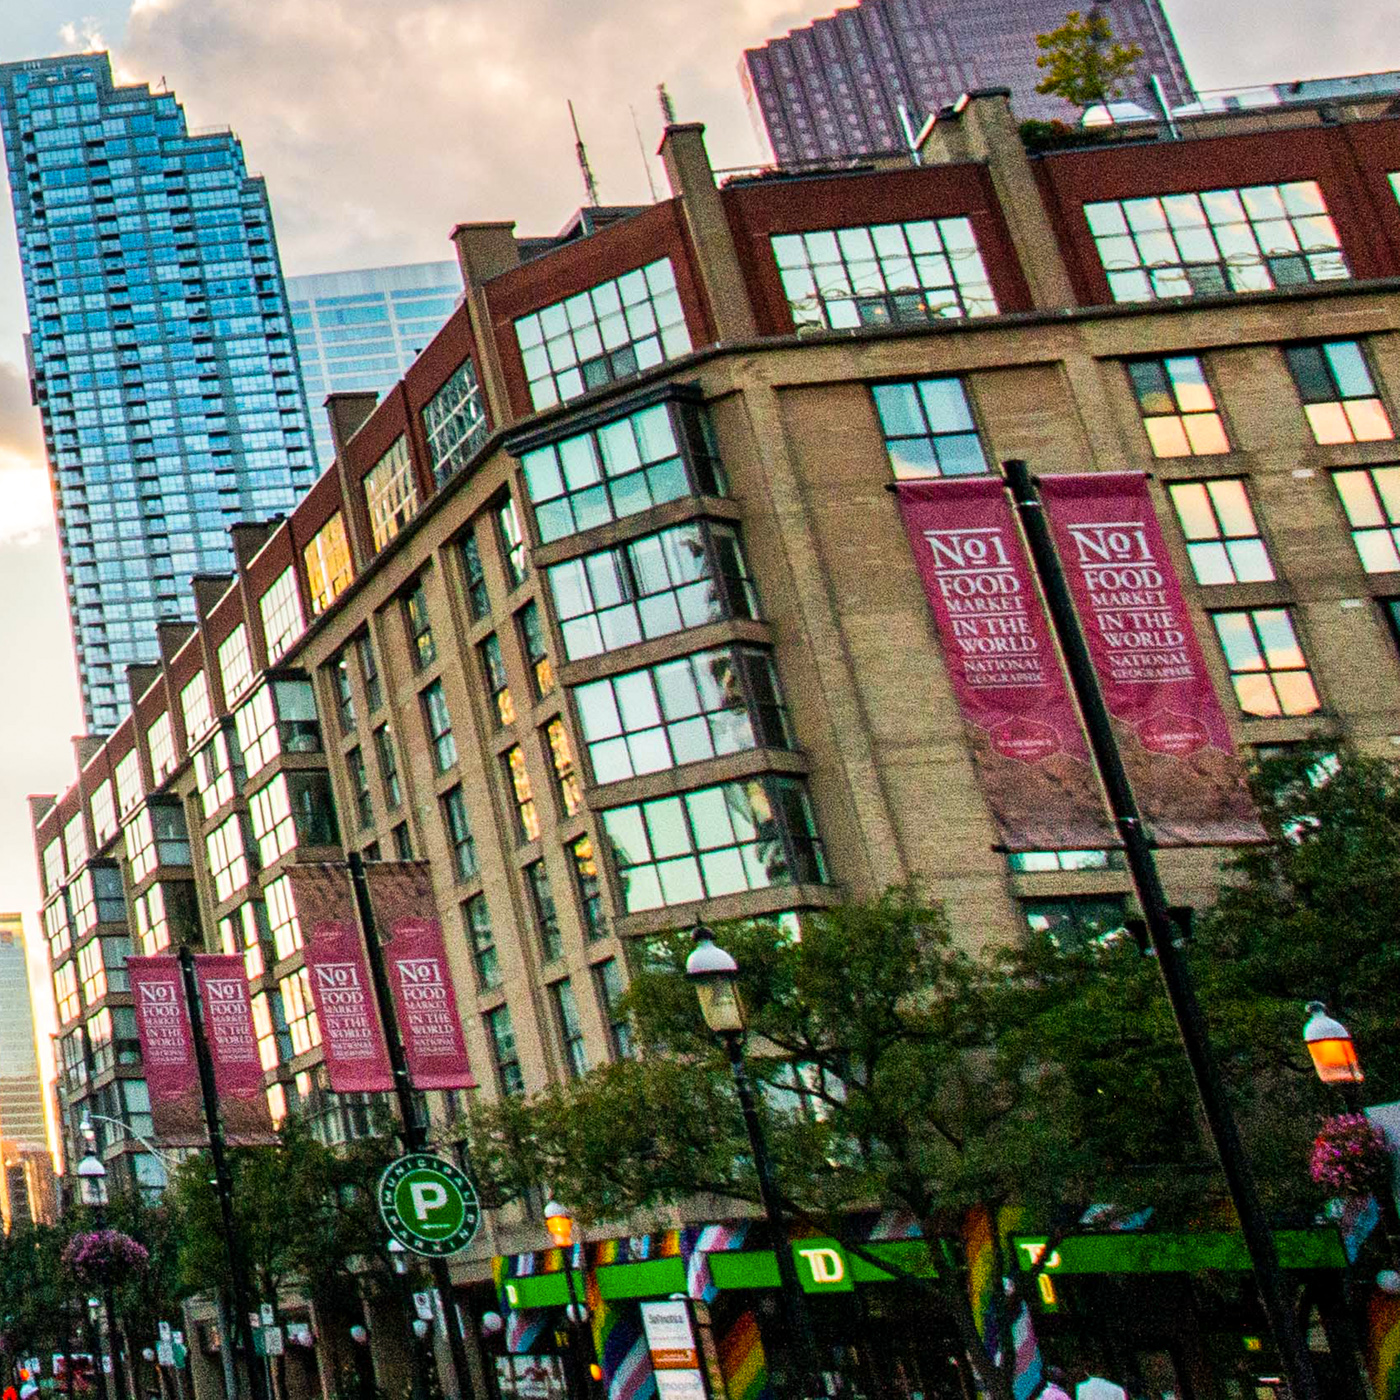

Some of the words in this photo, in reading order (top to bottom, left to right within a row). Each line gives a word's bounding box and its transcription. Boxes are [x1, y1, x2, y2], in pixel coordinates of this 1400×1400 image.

[938, 574, 1020, 596] FOOD
[1084, 569, 1163, 590] FOOD
[945, 596, 1024, 612] MARKET
[1090, 590, 1167, 606] MARKET
[952, 620, 979, 636] IN
[982, 617, 1032, 634] THE
[1097, 614, 1125, 630] IN
[1128, 612, 1178, 629] THE
[957, 635, 1038, 653] WORLD
[1102, 630, 1185, 648] WORLD
[964, 658, 1041, 672] NATIONAL
[1110, 651, 1191, 666] NATIONAL
[321, 991, 364, 1004] FOOD
[402, 987, 446, 1000] FOOD
[142, 1005, 179, 1017] FOOD
[210, 1004, 247, 1015] FOOD
[323, 1004, 367, 1014] MARKET
[404, 1000, 448, 1010] MARKET
[326, 1018, 343, 1028] IN
[344, 1016, 370, 1028] THE
[408, 1014, 424, 1024] IN
[425, 1012, 451, 1023] THE
[146, 1029, 159, 1039] IN
[162, 1027, 183, 1038] THE
[214, 1026, 227, 1036] IN
[229, 1025, 249, 1035] THE
[328, 1028, 371, 1039] WORLD
[411, 1024, 454, 1035] WORLD
[147, 1038, 185, 1047] WORLD
[216, 1035, 253, 1044] WORLD
[410, 1182, 448, 1220] P
[799, 1248, 844, 1283] TD
